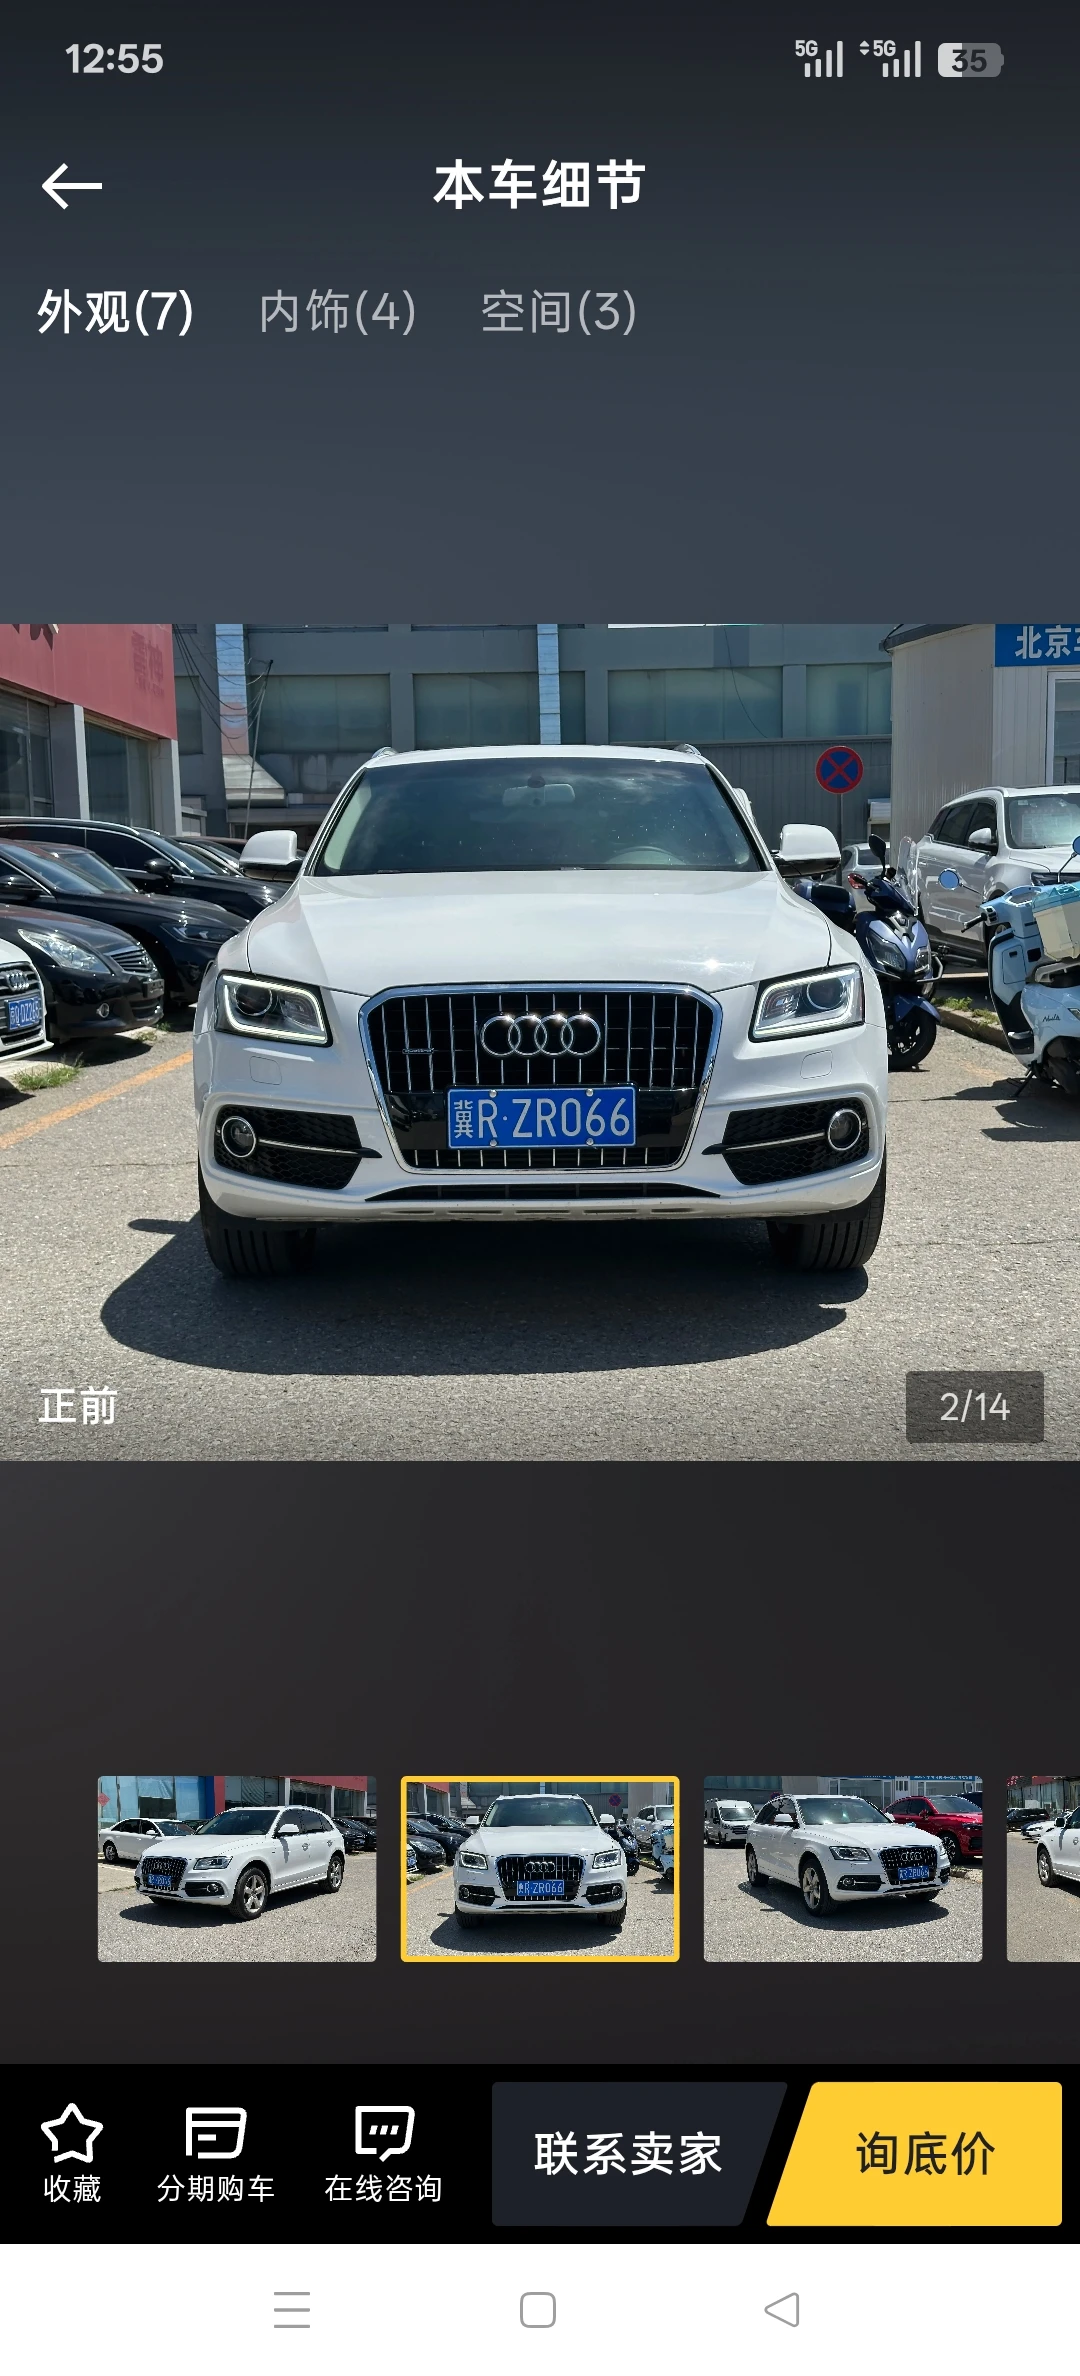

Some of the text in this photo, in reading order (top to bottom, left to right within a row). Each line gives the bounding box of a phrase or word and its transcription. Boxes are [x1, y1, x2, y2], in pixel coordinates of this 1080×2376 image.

[66, 43, 164, 74] 12:55
[795, 40, 818, 57] 5G
[873, 40, 896, 57] 5G
[951, 49, 988, 72] 35
[433, 158, 646, 210] 本车细节
[37, 289, 193, 337] 外观(7)
[261, 289, 416, 336] 内饰(4)
[481, 289, 637, 336] 空间(3)
[1015, 625, 1080, 659] 北京
[534, 2131, 723, 2177] 联系卖家
[856, 2131, 996, 2177] 询底价
[43, 2174, 102, 2203] 收藏
[157, 2174, 276, 2203] 分期购车
[325, 2174, 442, 2203] 在线咨询
